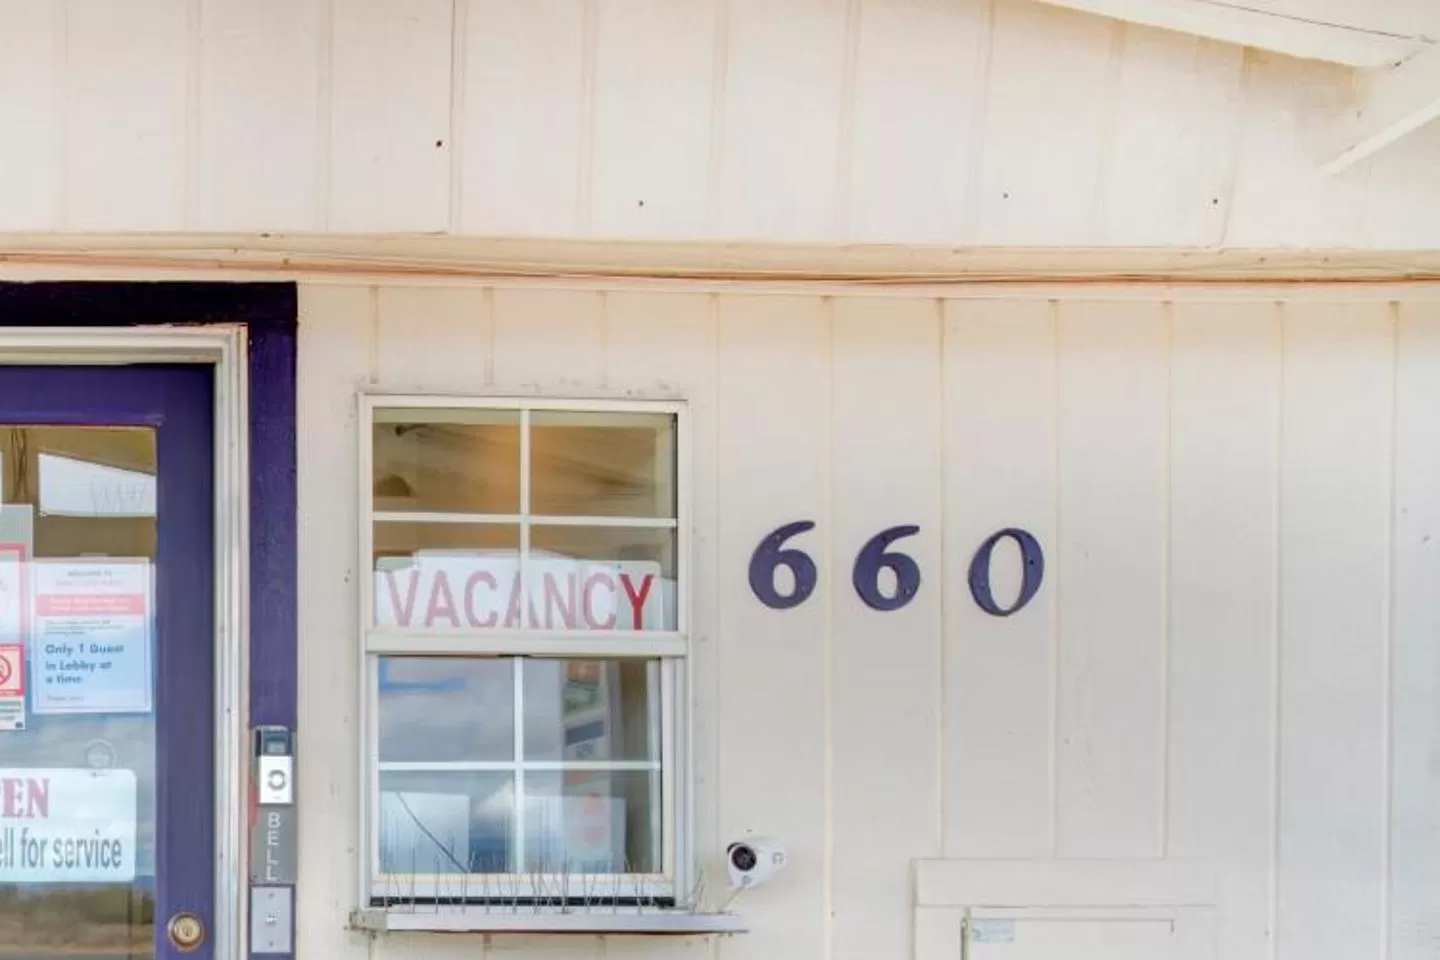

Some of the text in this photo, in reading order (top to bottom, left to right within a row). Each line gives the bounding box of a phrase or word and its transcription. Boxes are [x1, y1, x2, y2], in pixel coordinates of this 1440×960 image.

[748, 520, 1044, 617] 660
[385, 569, 654, 631] VACANCY
[44, 643, 73, 657] Only
[60, 660, 96, 672] Lobby
[57, 674, 82, 684] time
[20, 827, 49, 869] for
[53, 829, 123, 869] service
[266, 811, 281, 882] BELL
